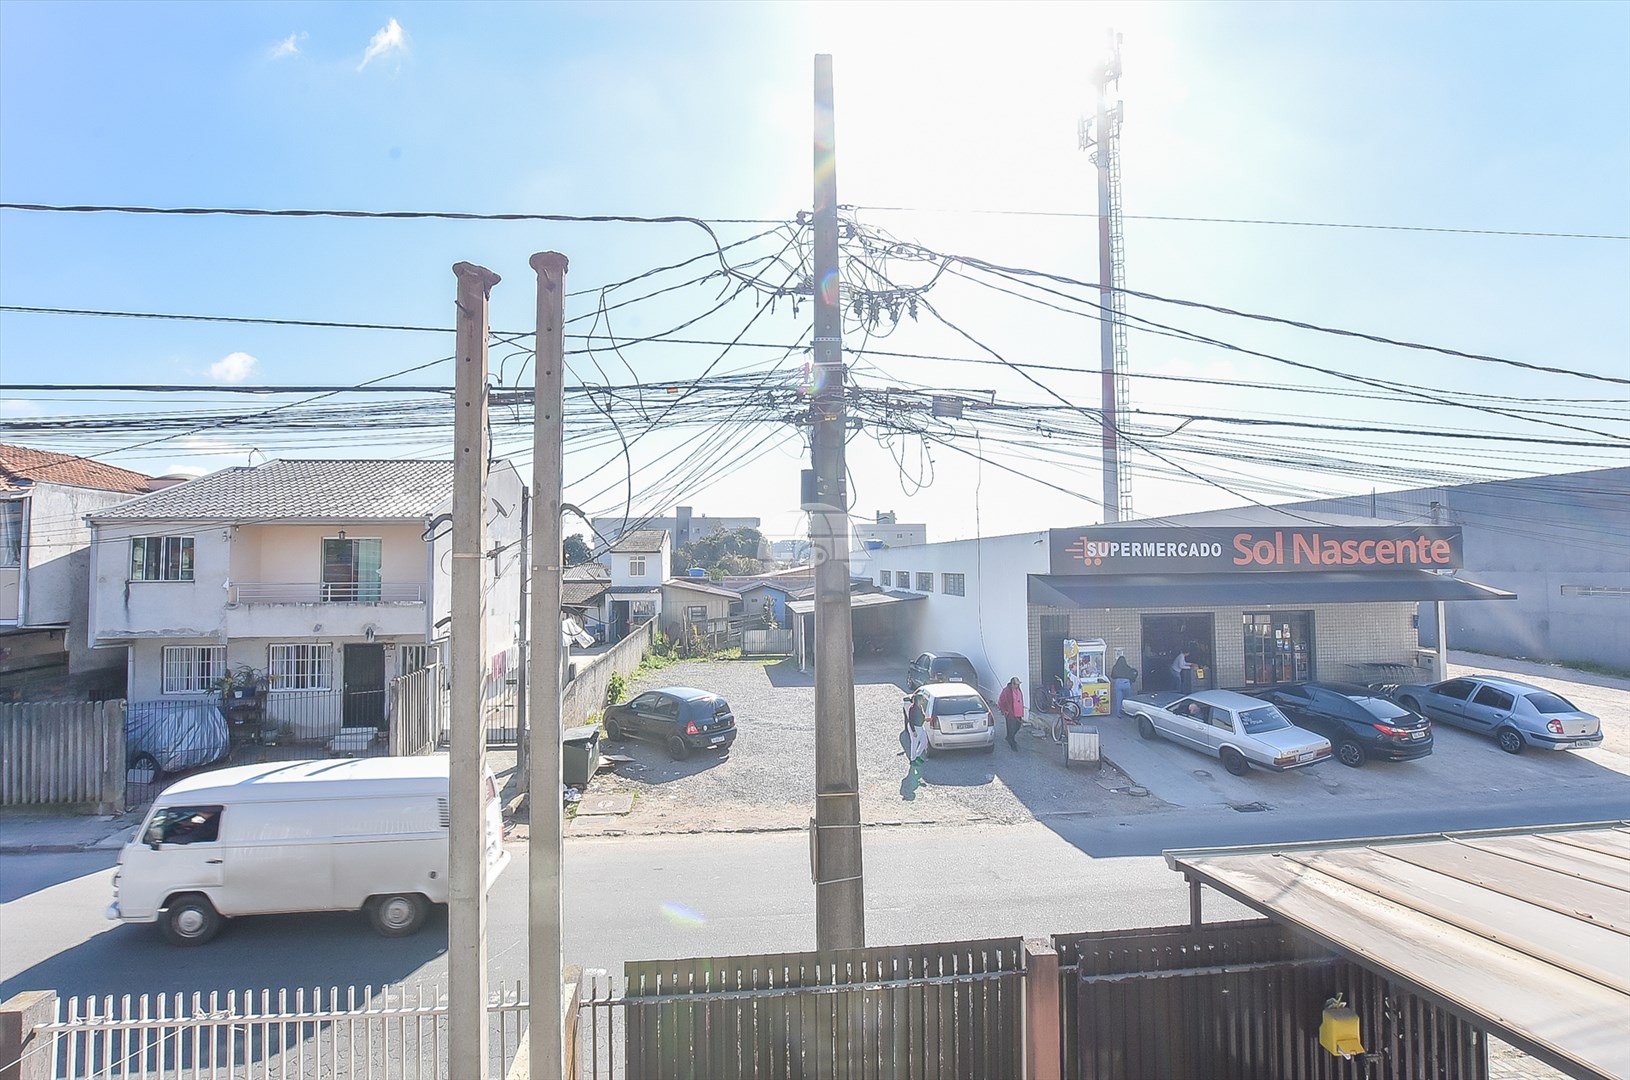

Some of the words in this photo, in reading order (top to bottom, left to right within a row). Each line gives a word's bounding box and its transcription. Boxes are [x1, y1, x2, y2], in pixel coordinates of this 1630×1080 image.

[1087, 542, 1222, 558] SUPERMERCADO
[1232, 531, 1283, 566] Sol
[1293, 533, 1450, 565] Nascente
